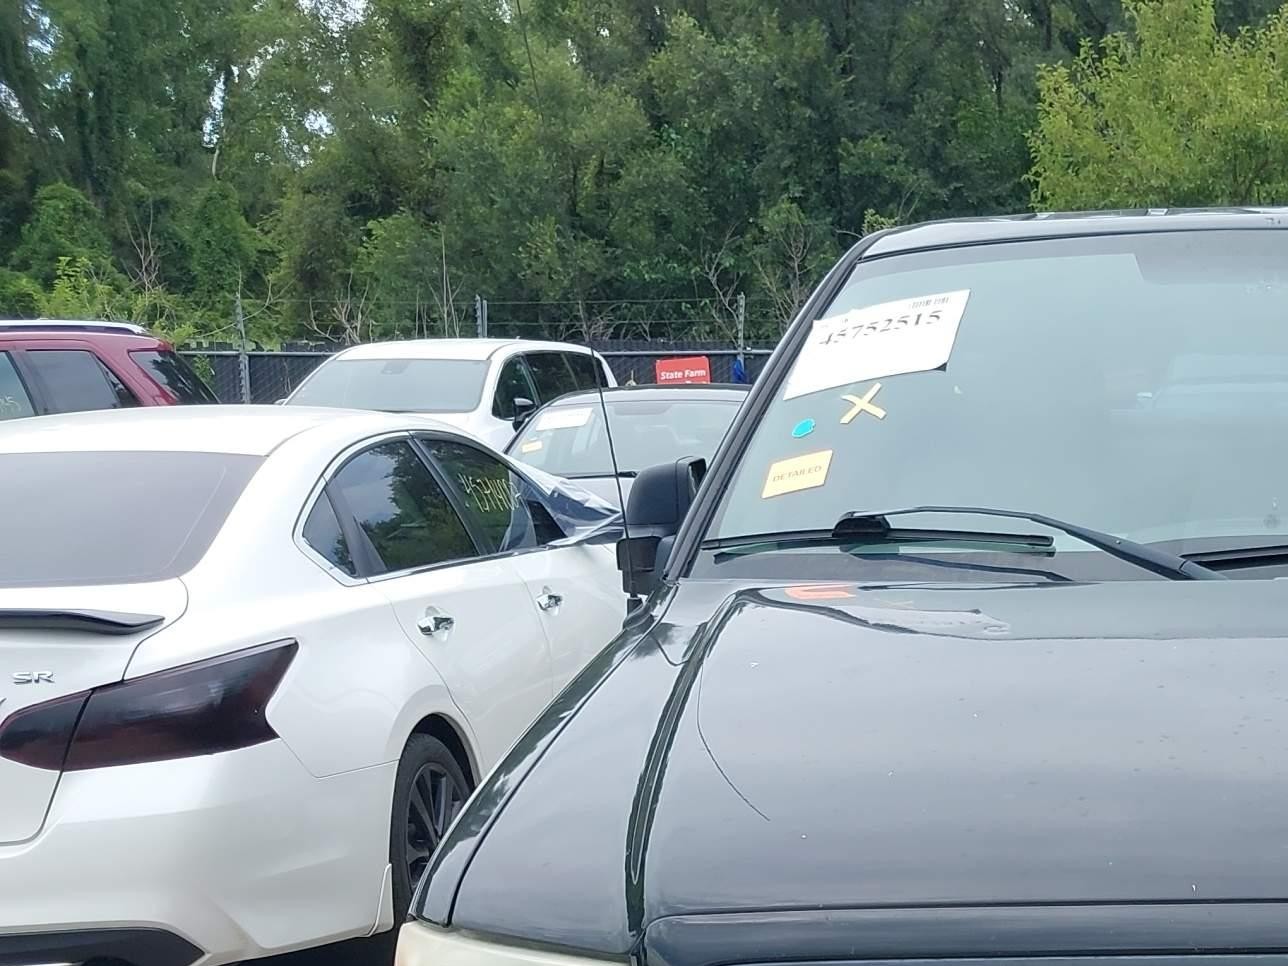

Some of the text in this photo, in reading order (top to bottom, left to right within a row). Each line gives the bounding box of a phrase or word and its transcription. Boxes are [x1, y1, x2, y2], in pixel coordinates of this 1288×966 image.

[818, 310, 943, 345] 45752515
[660, 369, 706, 380] State Farm
[771, 464, 823, 482] DETAILED
[12, 671, 55, 685] SR
